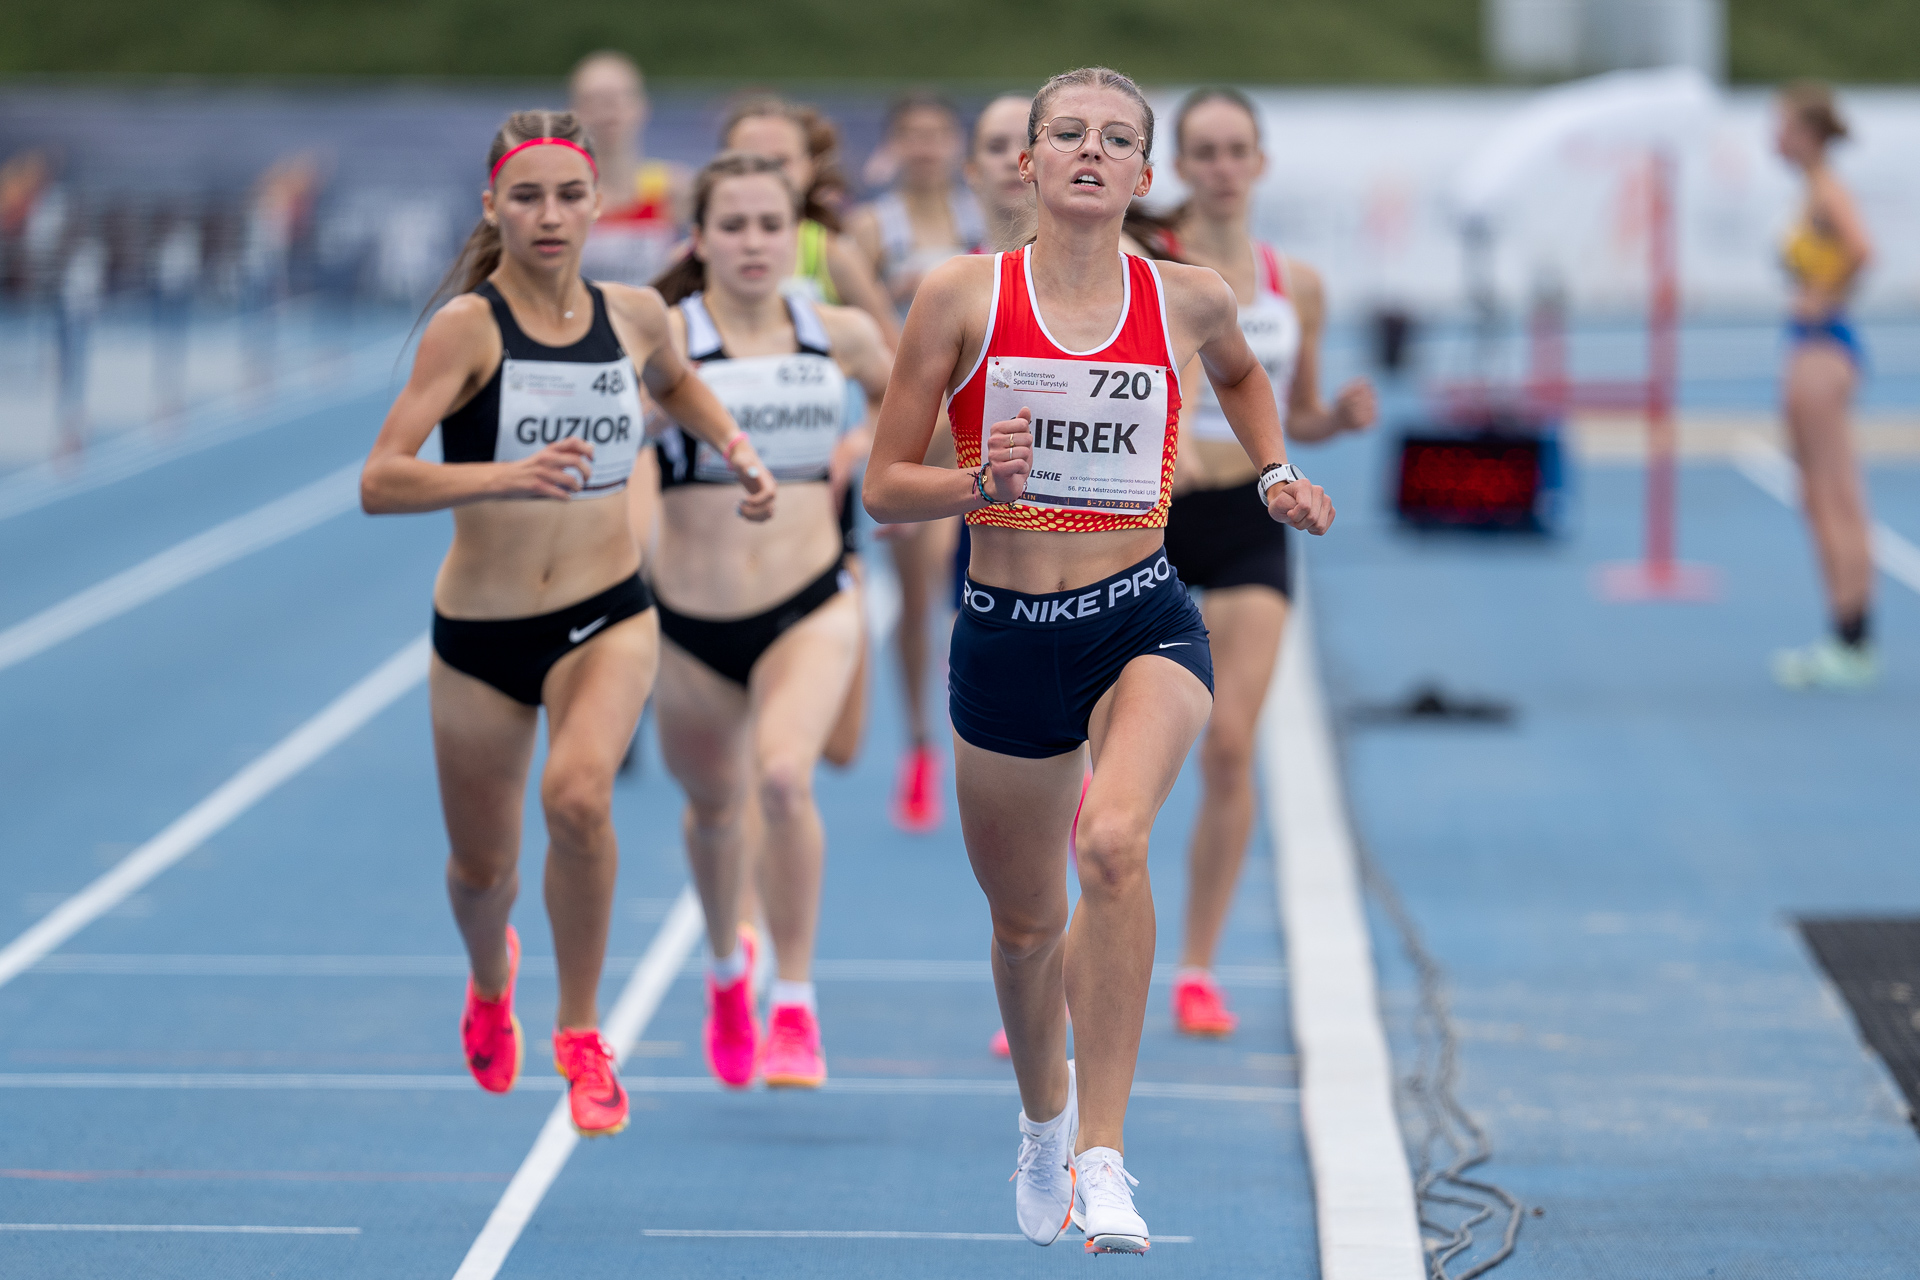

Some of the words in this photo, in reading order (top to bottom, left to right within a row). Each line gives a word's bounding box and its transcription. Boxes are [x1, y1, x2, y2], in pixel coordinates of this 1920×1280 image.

[1013, 370, 1056, 379] Ministerstwo
[1013, 378, 1035, 387] Sportu
[1040, 379, 1069, 388] Turystyki
[1089, 369, 1152, 401] 720
[515, 415, 631, 446] GUZIOR
[1011, 416, 1140, 455] IEREK
[1030, 469, 1062, 482] LSKIE
[1022, 493, 1036, 501] LIN
[1086, 499, 1141, 509] 5-7.07.2024
[1011, 589, 1101, 623] NIKE
[1108, 556, 1170, 608] PRO
